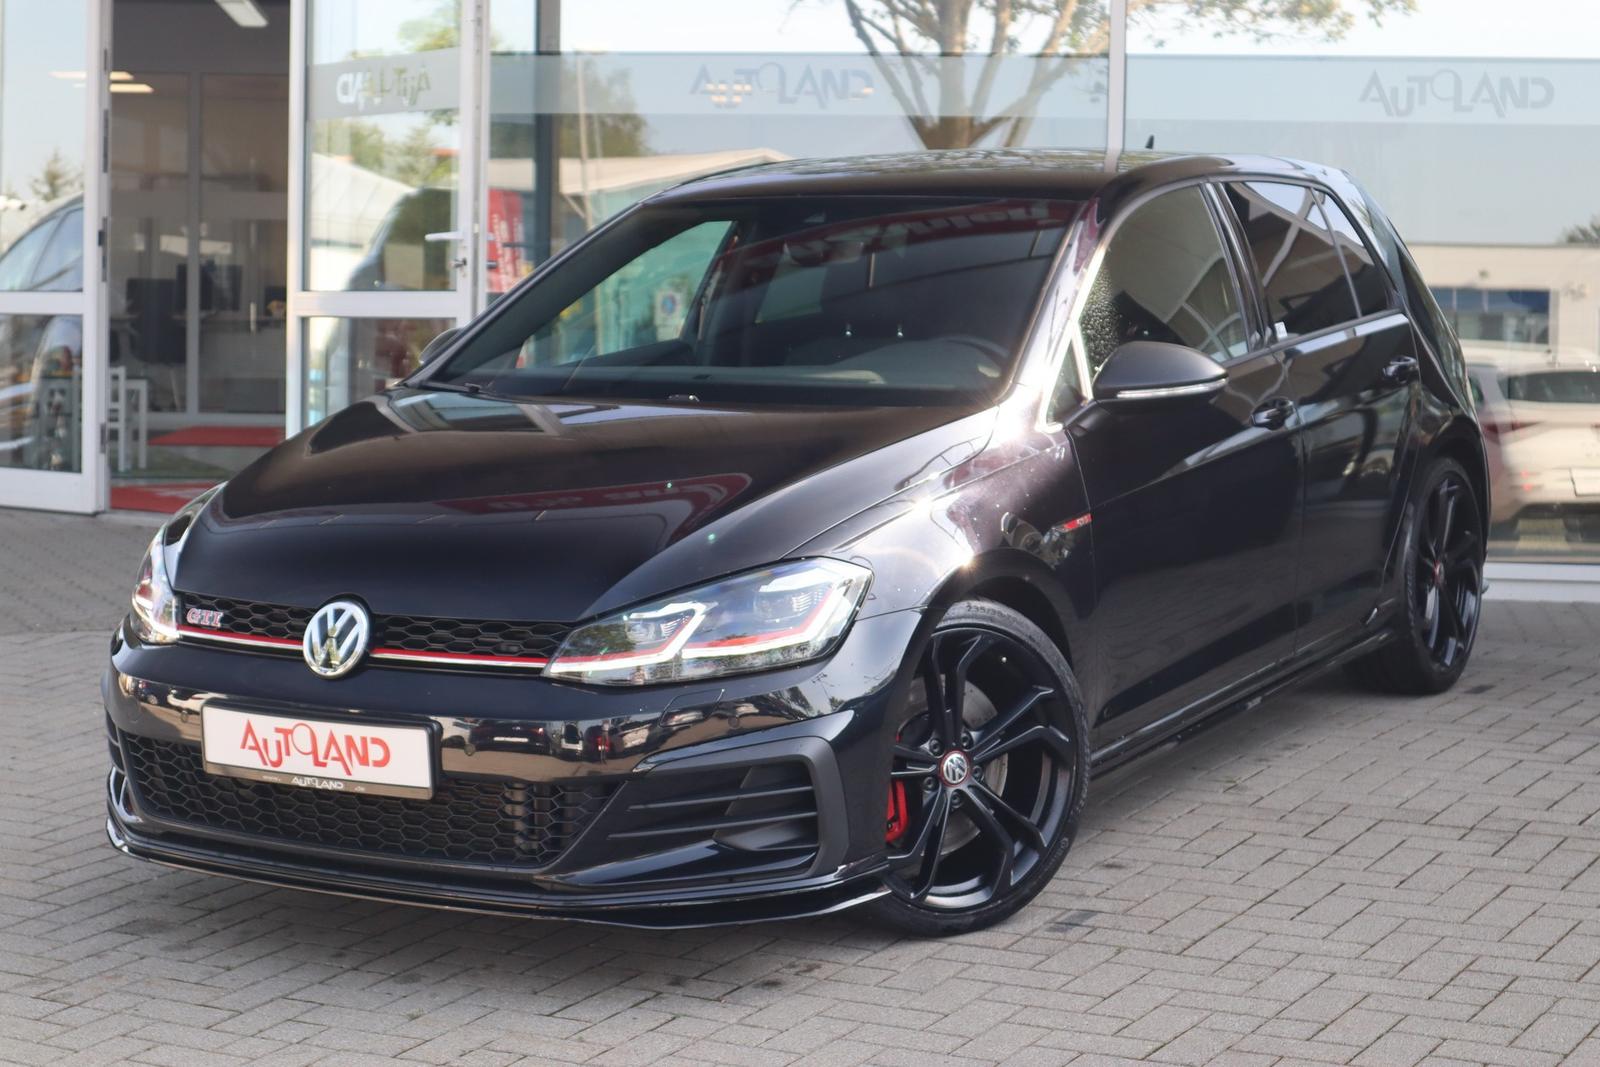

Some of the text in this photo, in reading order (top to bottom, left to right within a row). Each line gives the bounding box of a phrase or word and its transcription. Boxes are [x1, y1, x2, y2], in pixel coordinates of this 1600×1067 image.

[1359, 68, 1555, 118] AUTOLAND
[186, 607, 224, 627] GTI
[240, 719, 391, 776] AUTOLAND
